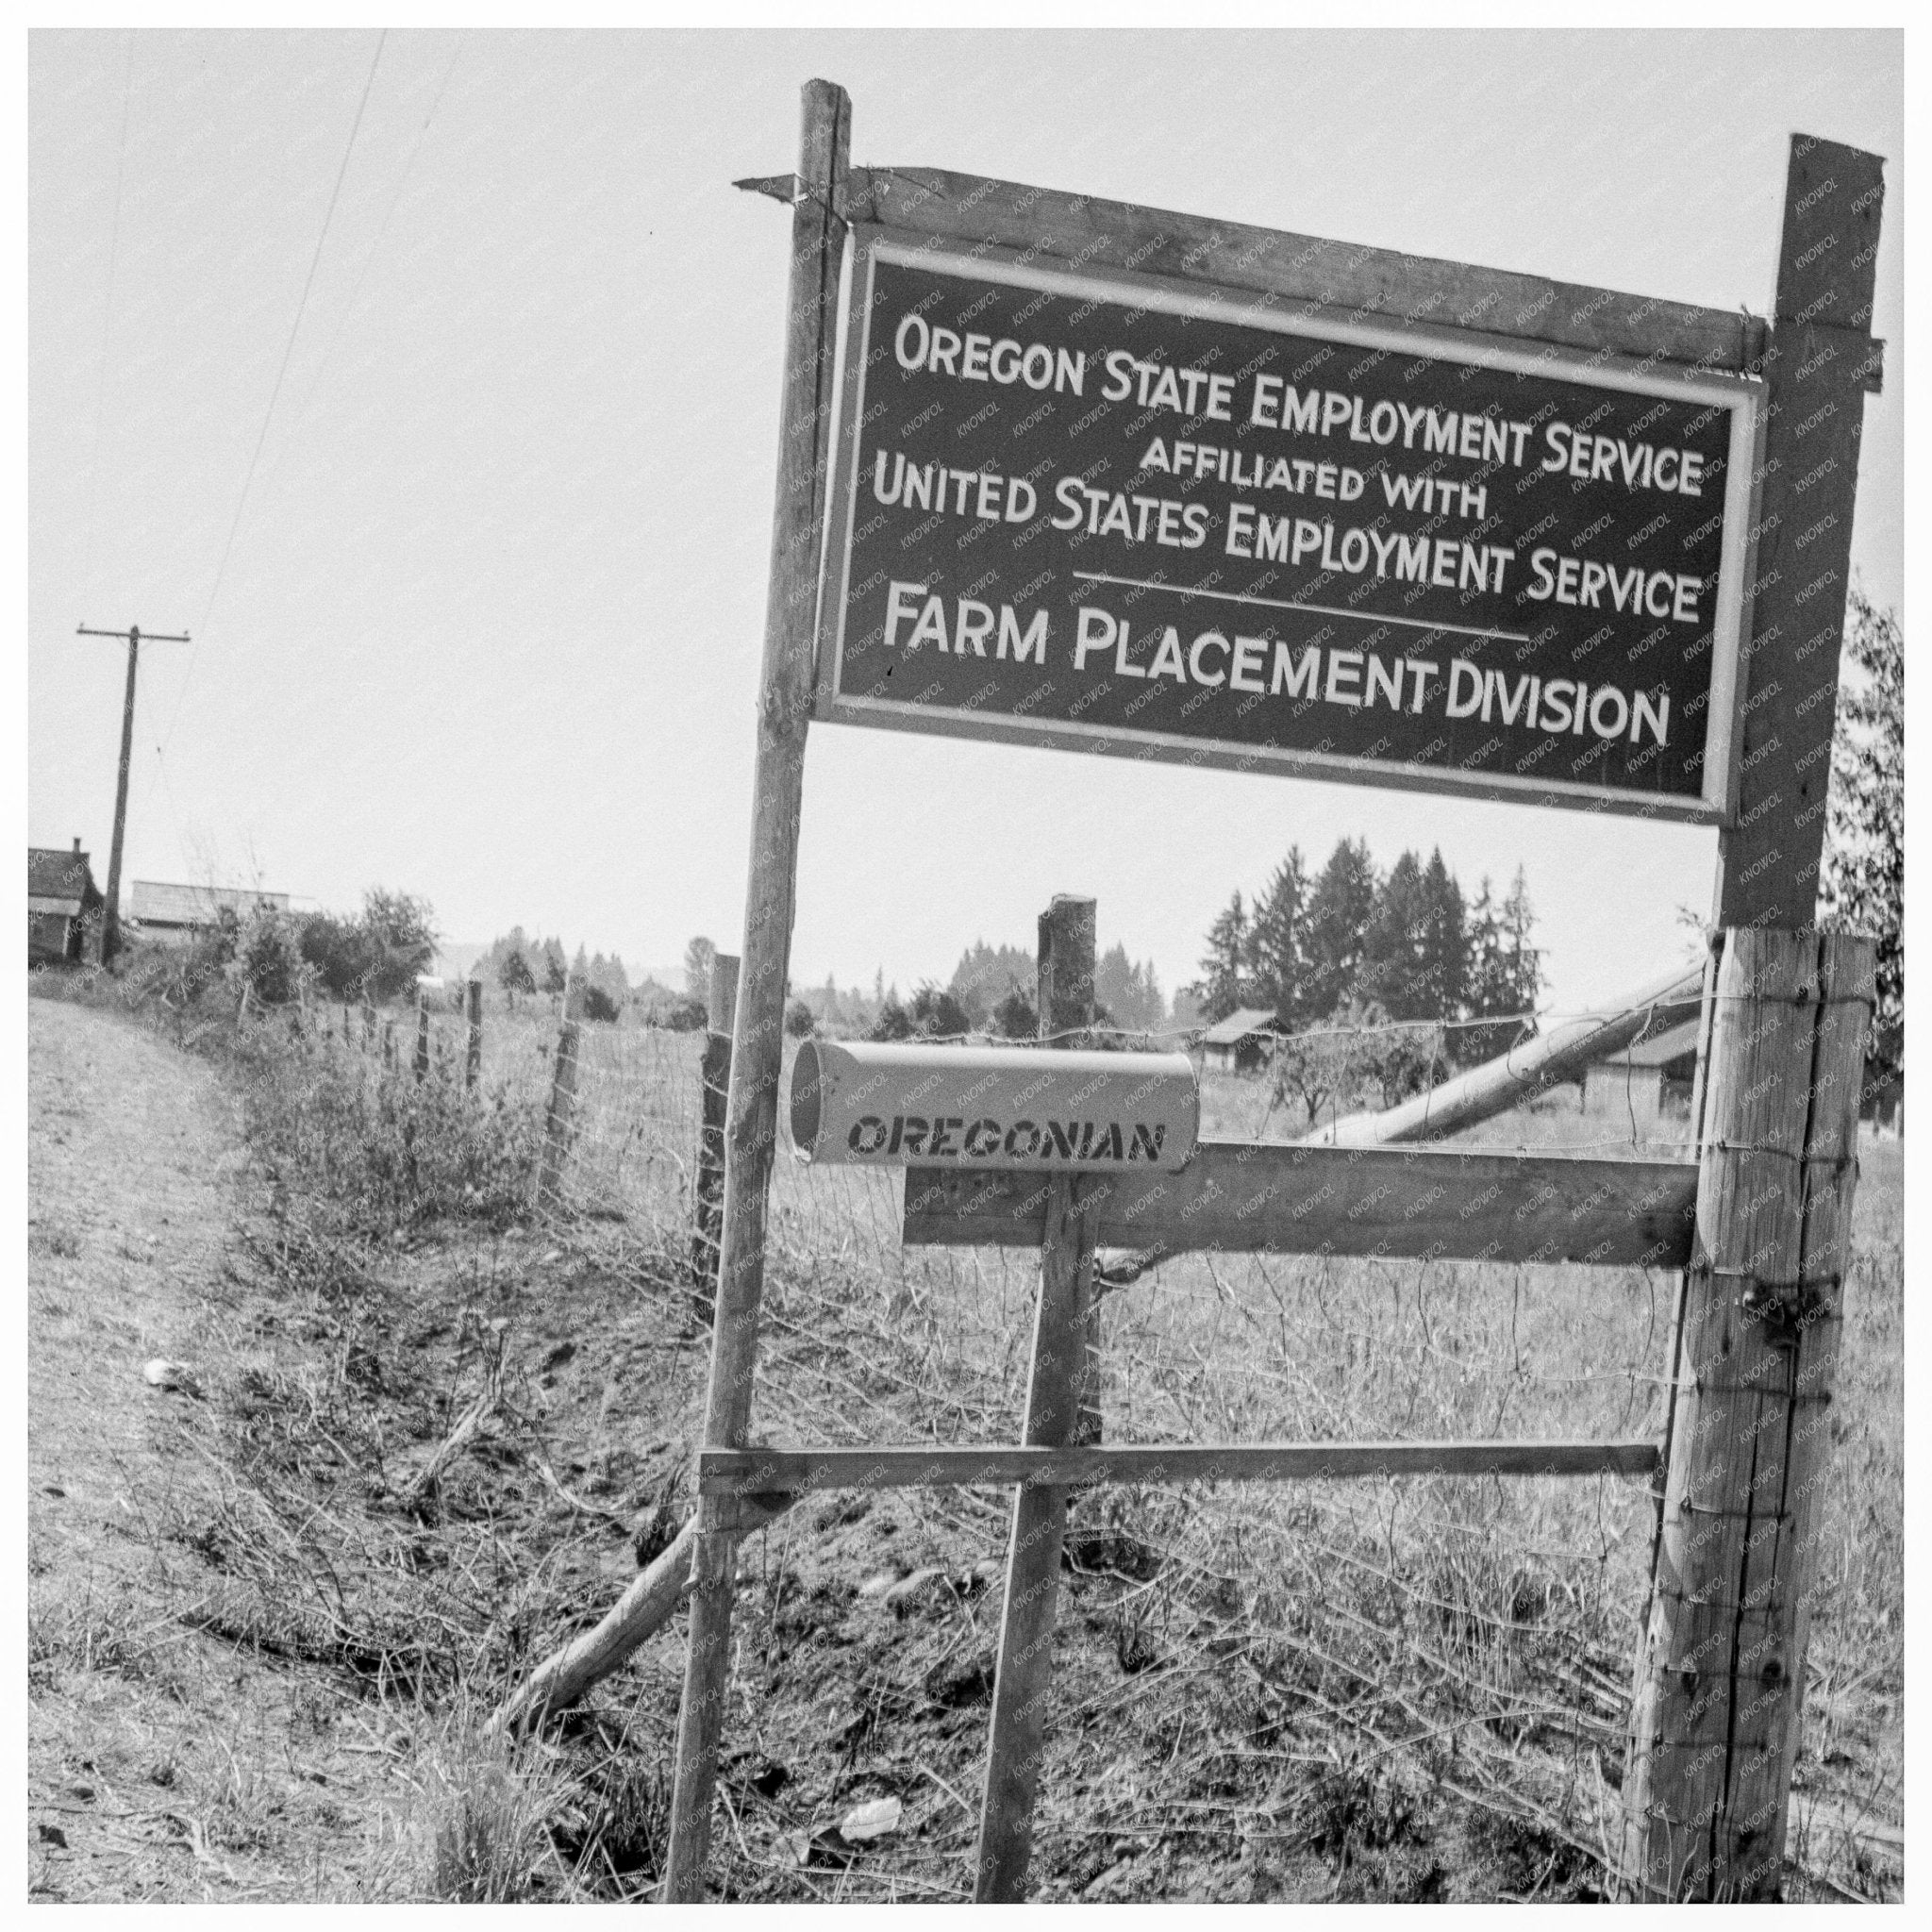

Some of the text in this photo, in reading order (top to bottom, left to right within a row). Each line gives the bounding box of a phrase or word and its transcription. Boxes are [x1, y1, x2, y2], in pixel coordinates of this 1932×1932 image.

[895, 315, 1704, 496] OREGON STATE EMPLOYMENT SERVICE
[1139, 437, 1487, 519] AFFILIATED WITH
[874, 449, 1701, 623] UNITED STATES EMPLOYMENT SERVICE
[883, 580, 1670, 746] FARM PLACEMENT DIVISION
[848, 1115, 1166, 1161] OREGONIAN
